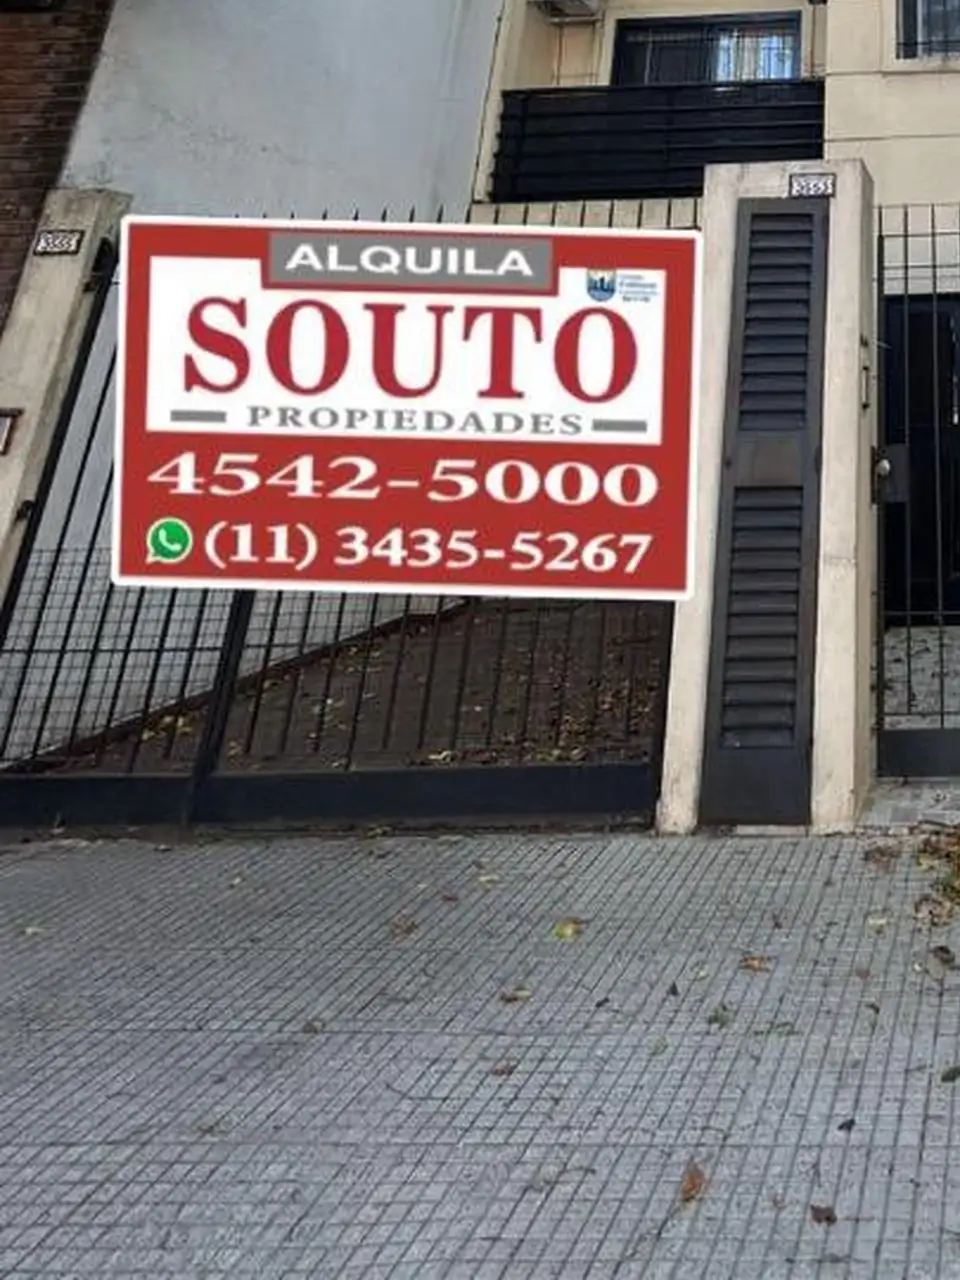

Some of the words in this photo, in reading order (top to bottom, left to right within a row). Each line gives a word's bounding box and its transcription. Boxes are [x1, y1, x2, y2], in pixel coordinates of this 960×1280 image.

[285, 243, 533, 277] ALQUILA
[183, 296, 638, 403] SOUTO
[247, 405, 583, 437] PROPIEDADES
[147, 451, 659, 507] 4542-5000
[204, 521, 318, 570] (11)
[334, 525, 654, 574] 3435-5267
